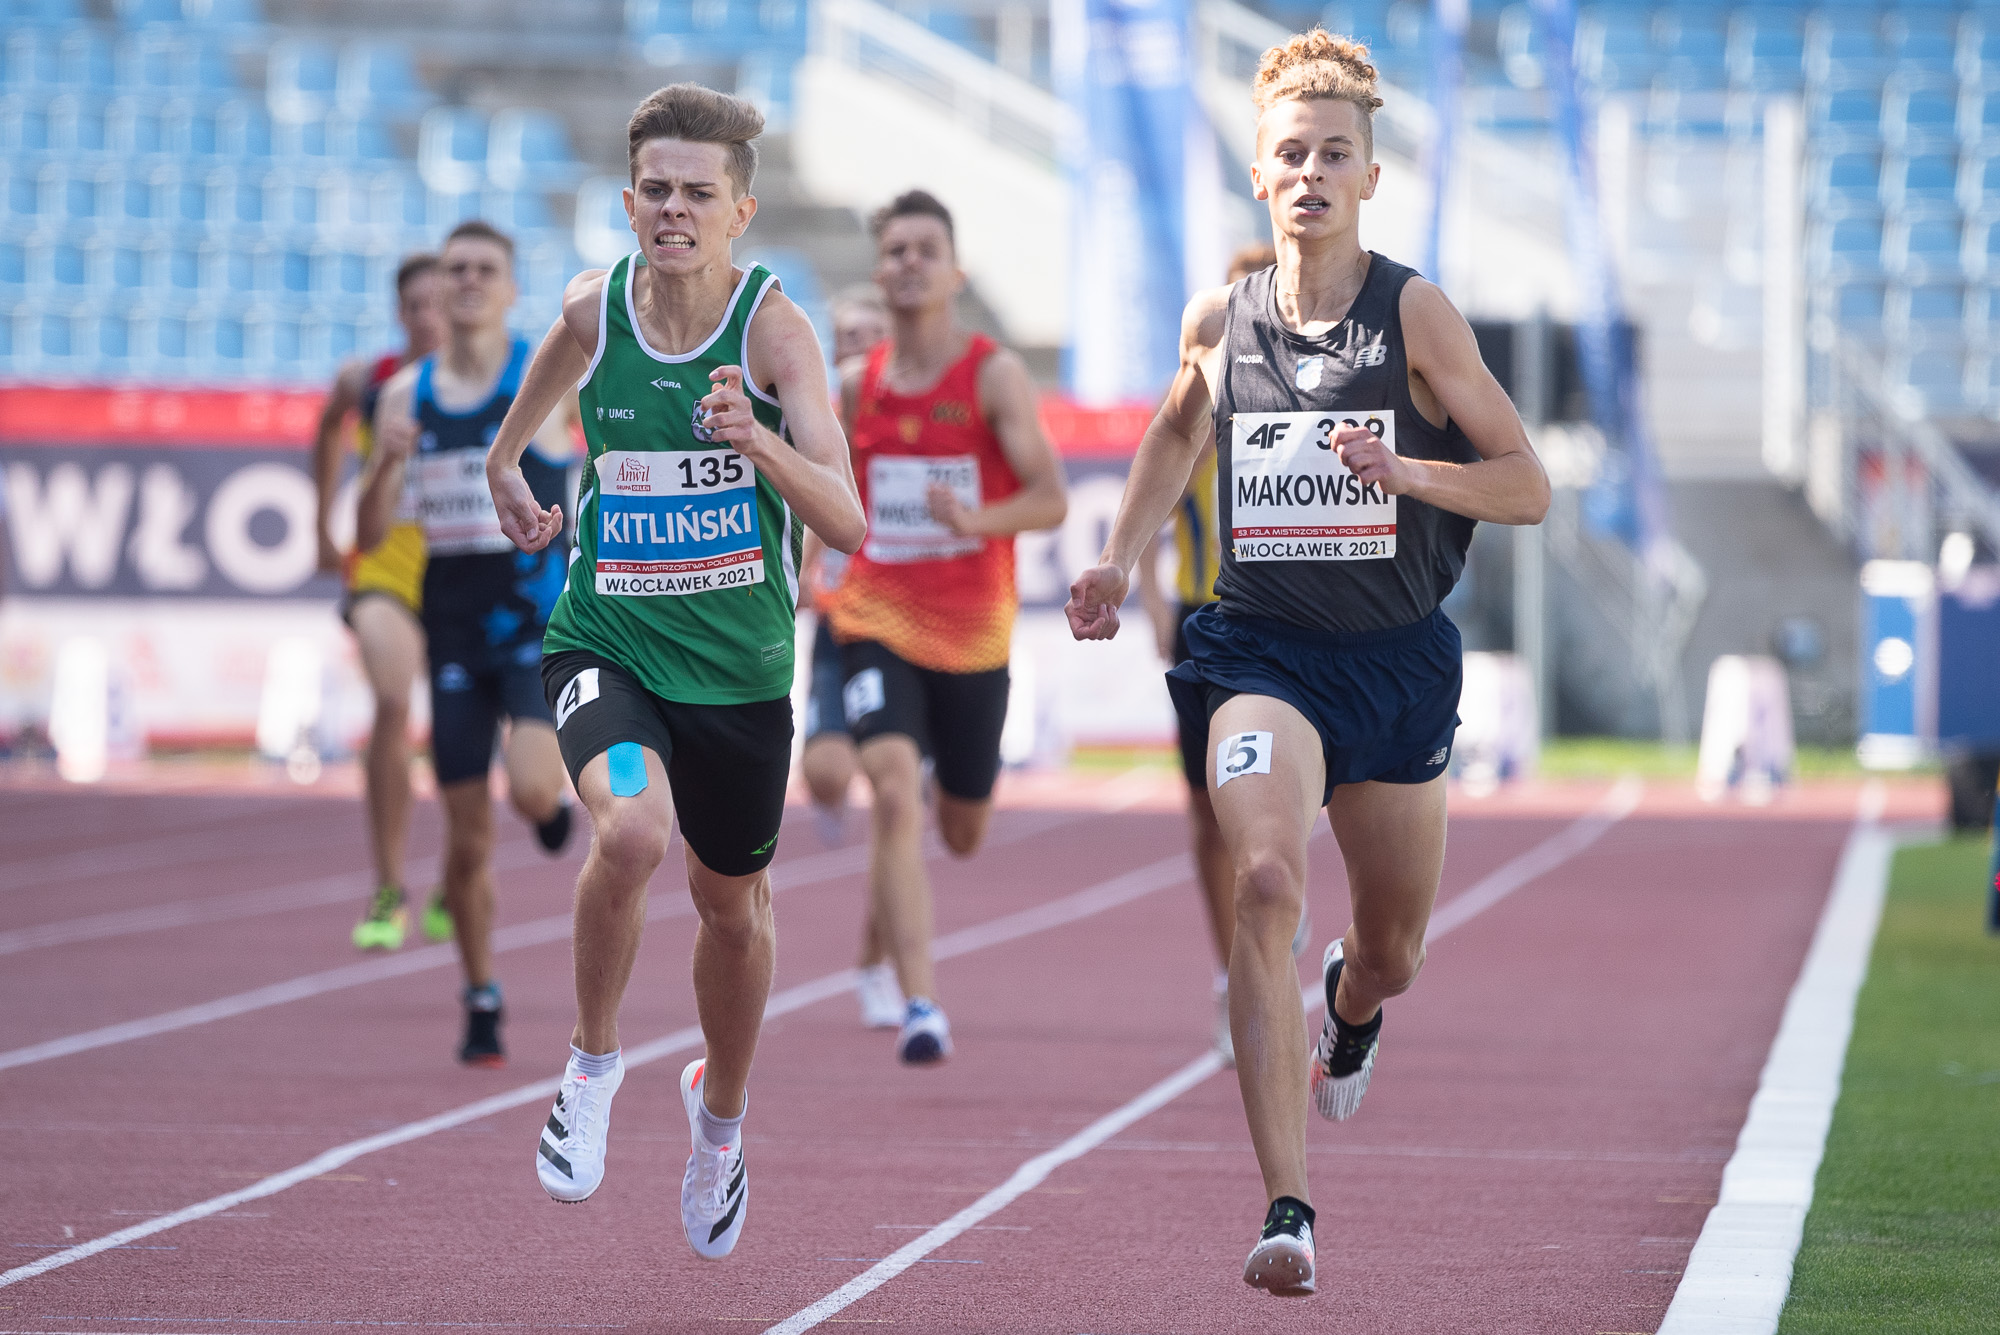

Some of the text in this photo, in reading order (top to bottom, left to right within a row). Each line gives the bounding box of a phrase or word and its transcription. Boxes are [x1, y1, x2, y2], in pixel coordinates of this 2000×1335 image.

[608, 408, 635, 420] UMCS
[1246, 422, 1291, 449] 4F
[616, 460, 650, 482] Anwil
[678, 454, 743, 488] 135
[603, 502, 752, 544] KITLIŃSKI
[642, 562, 705, 572] MISTRZOSTWA
[707, 556, 737, 567] POLSKI
[739, 552, 755, 561] U18
[1239, 540, 1387, 558] WŁOCŁAWEK 2021
[605, 567, 754, 593] WŁOCŁAWEK 2021
[564, 677, 582, 714] 4
[1226, 734, 1258, 773] 5
